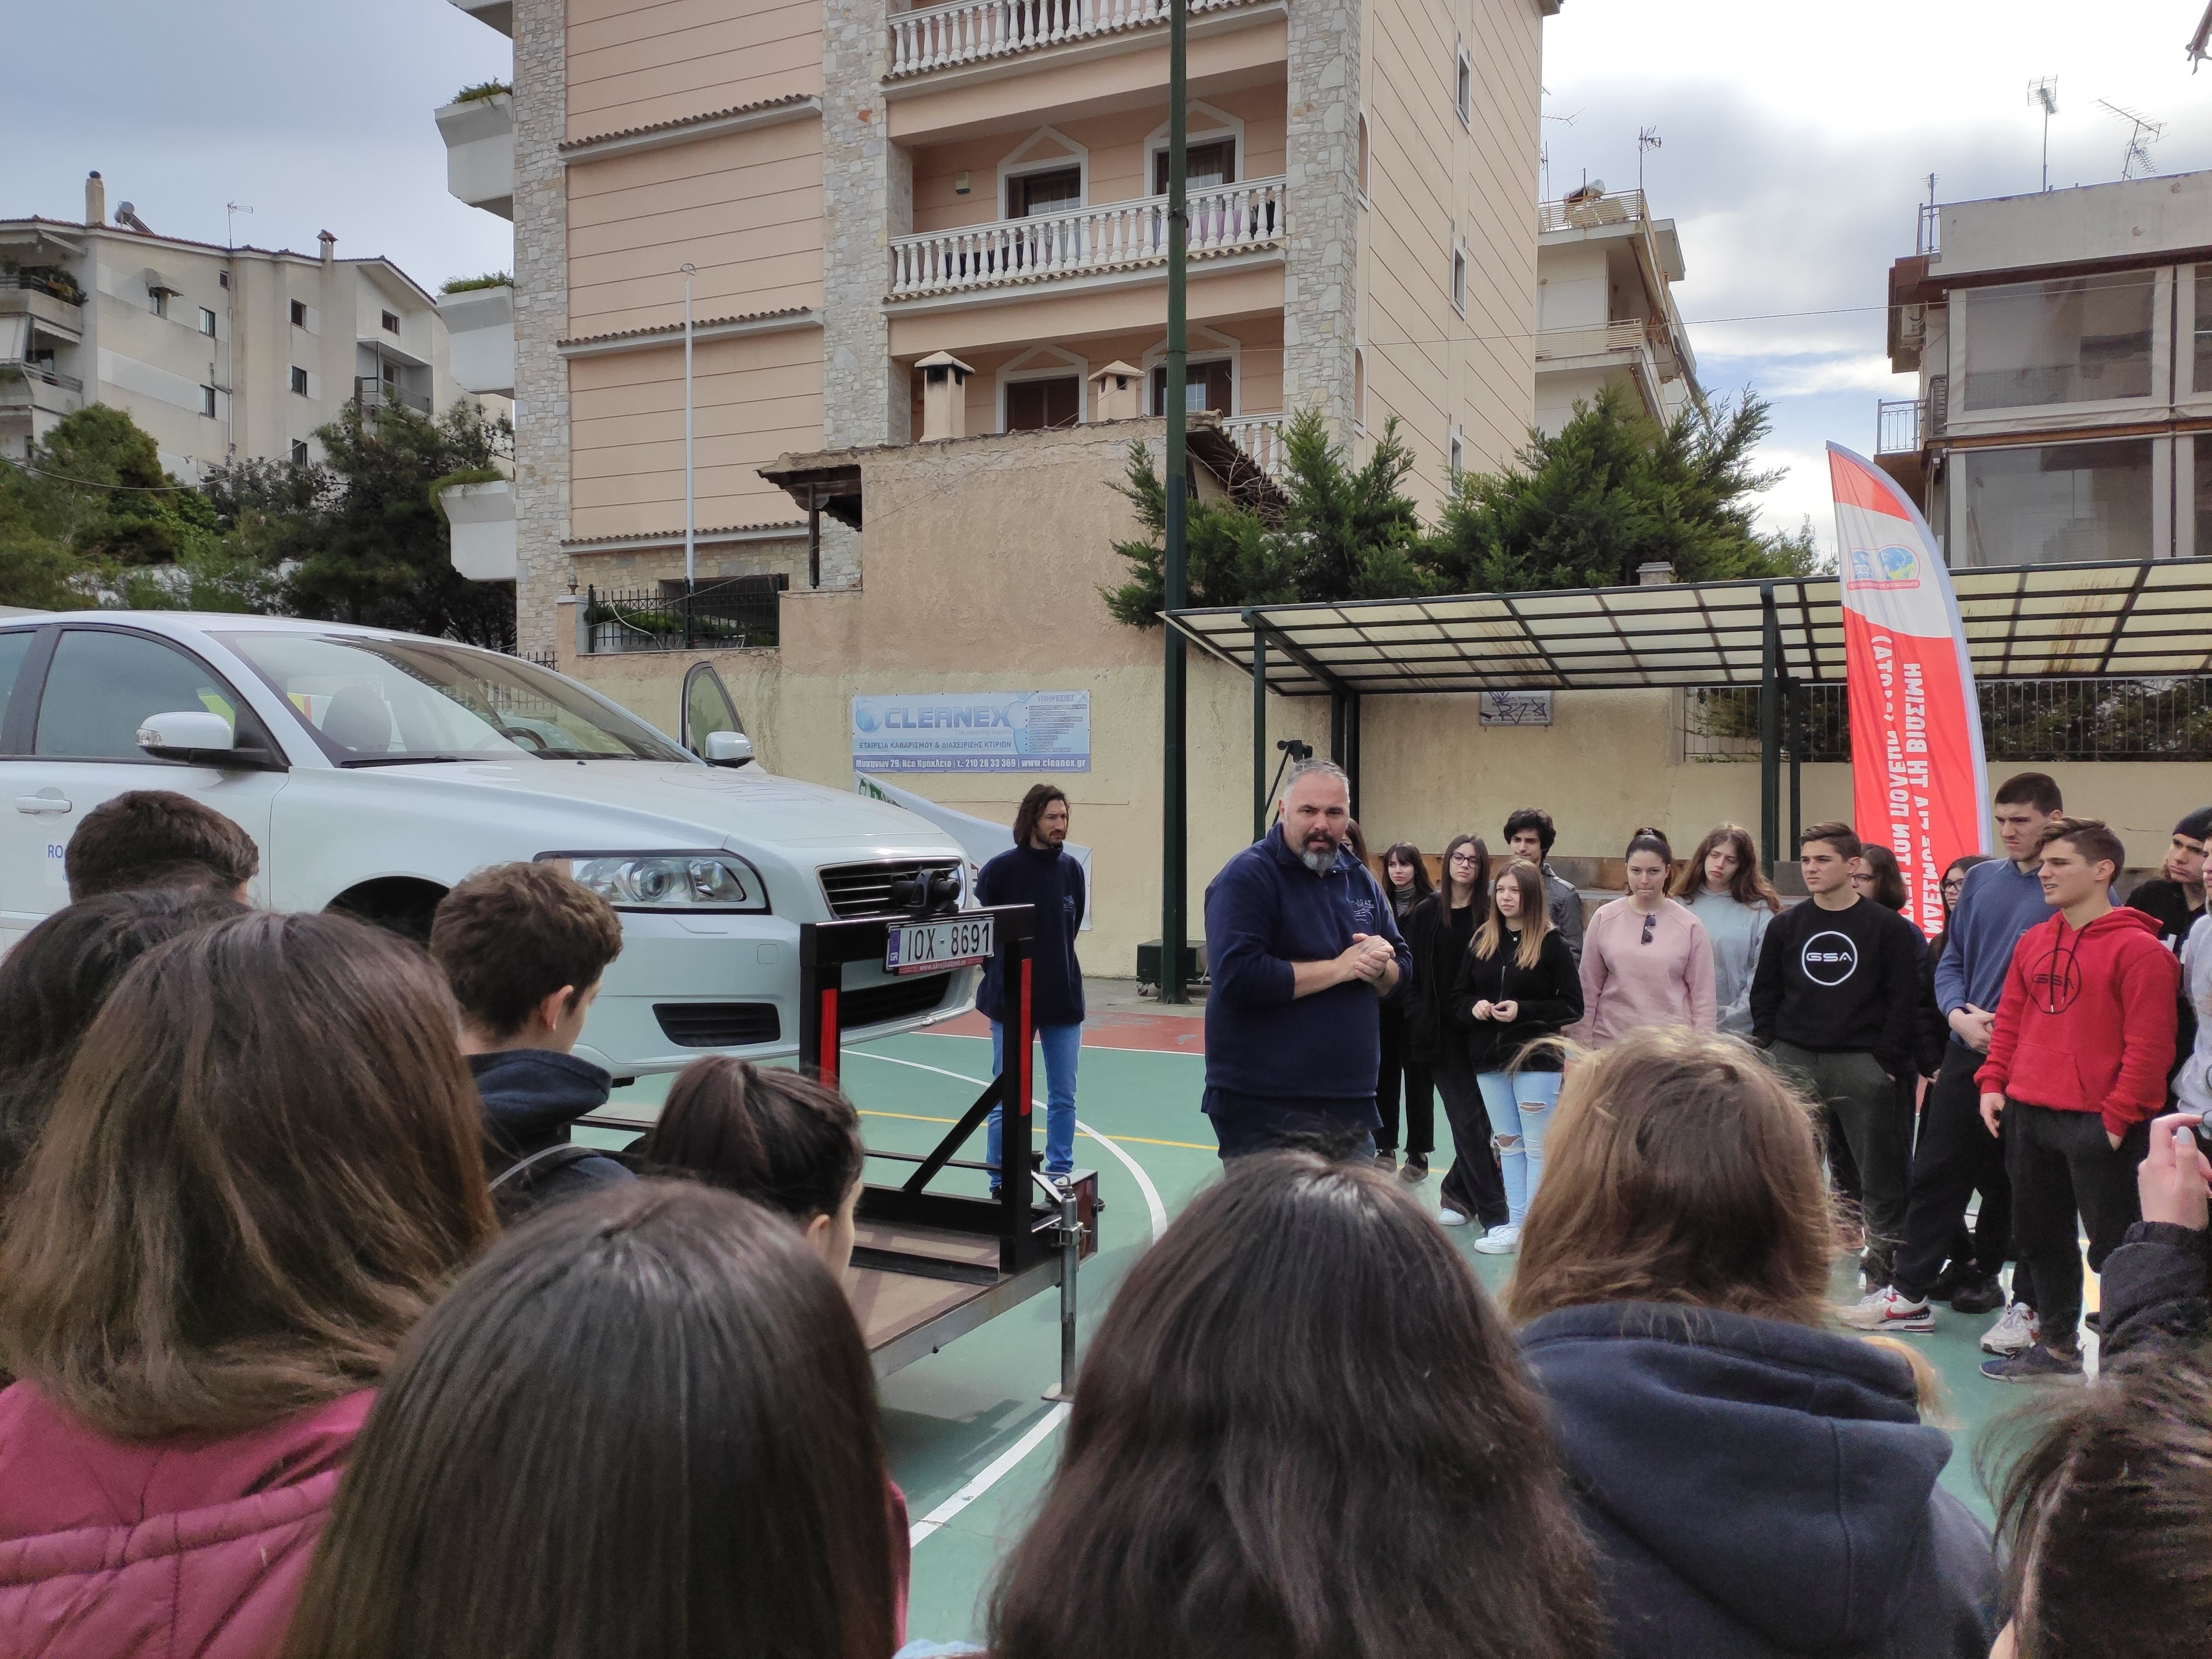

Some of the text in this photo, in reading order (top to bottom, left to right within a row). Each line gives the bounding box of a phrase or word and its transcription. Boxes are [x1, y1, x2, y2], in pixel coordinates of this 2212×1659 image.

[885, 706, 1011, 728] CLEANEX
[965, 759, 978, 768] 210
[979, 759, 989, 768] 28
[990, 759, 1000, 768] 33
[1001, 759, 1016, 768] 369
[1021, 759, 1086, 768] www.cleanex.gr
[890, 952, 898, 962] GR
[1806, 952, 1853, 962] GSA
